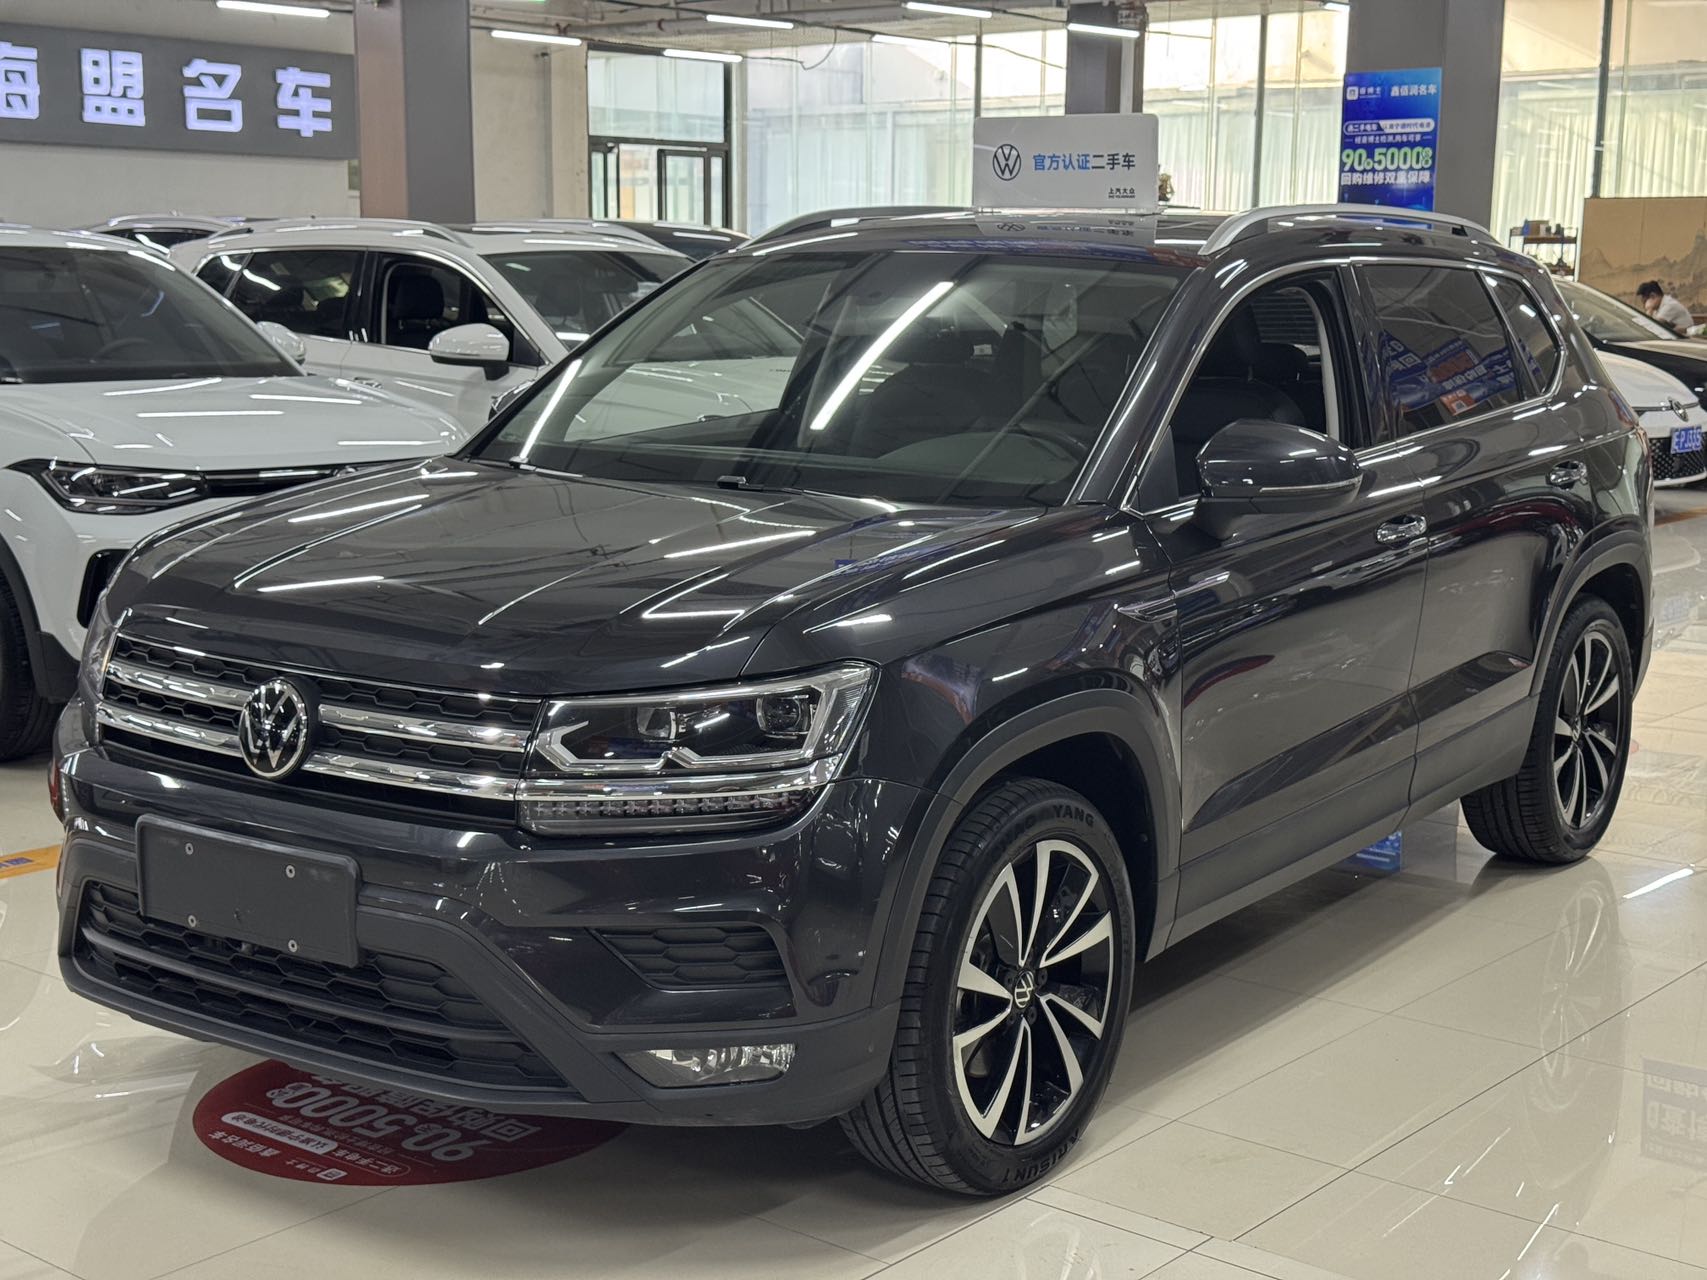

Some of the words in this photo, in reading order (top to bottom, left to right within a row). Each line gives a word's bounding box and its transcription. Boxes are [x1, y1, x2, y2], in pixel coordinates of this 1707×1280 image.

[1033, 152, 1136, 172] 官方认证二手车
[1108, 187, 1136, 195] 上汽大众
